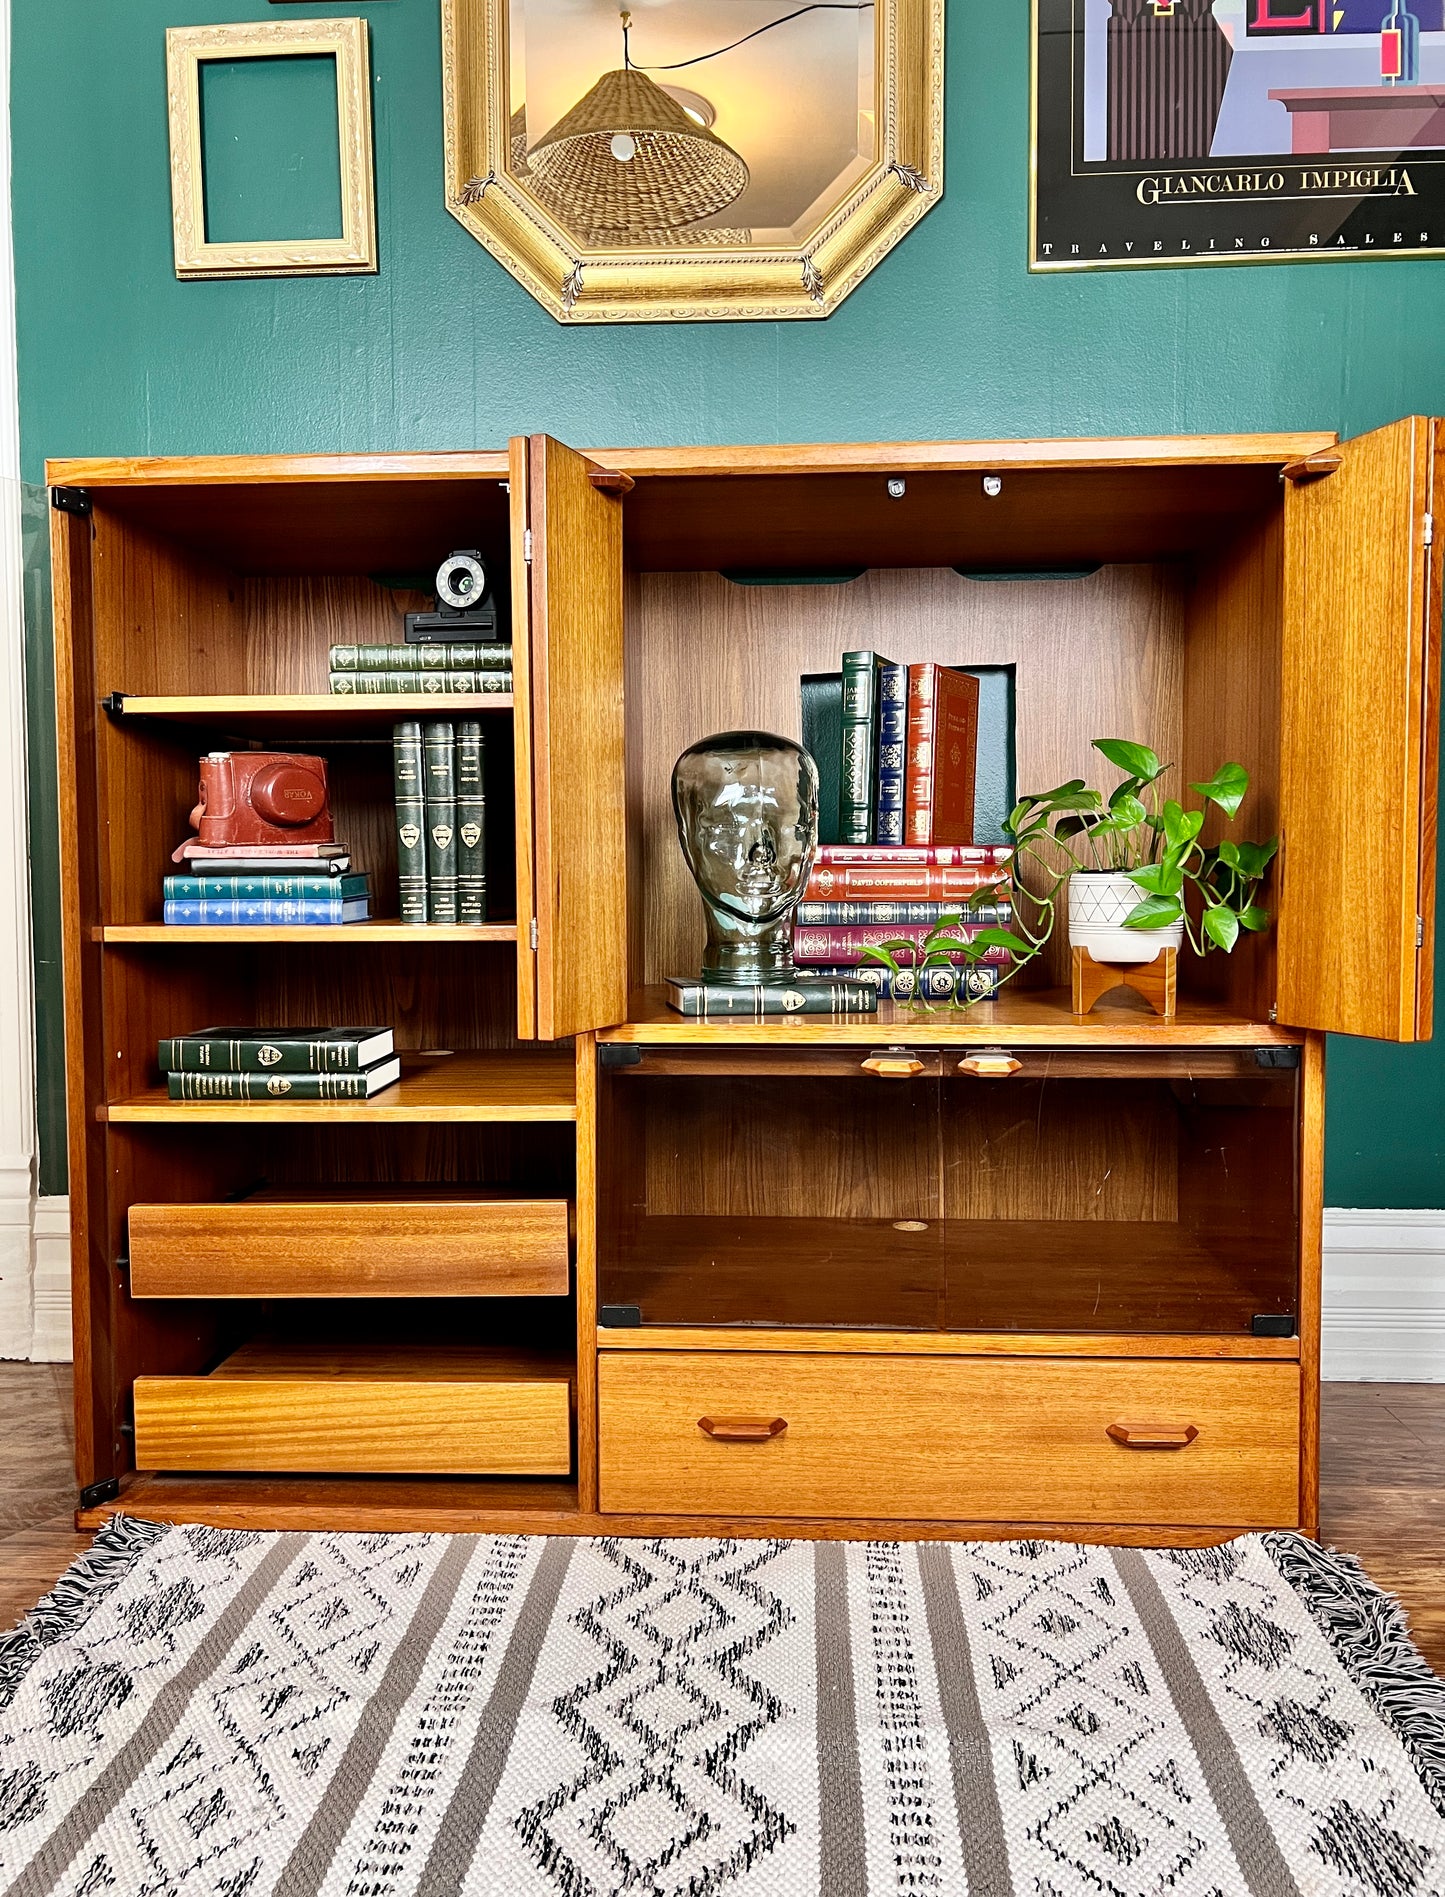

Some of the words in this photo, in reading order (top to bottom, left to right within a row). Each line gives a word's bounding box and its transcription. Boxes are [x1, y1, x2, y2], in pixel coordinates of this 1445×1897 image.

[1136, 171, 1285, 205] GIANCARLO
[1299, 168, 1419, 196] IMPIGLIA
[1042, 236, 1270, 255] TRAVELING
[1309, 231, 1428, 246] SALES
